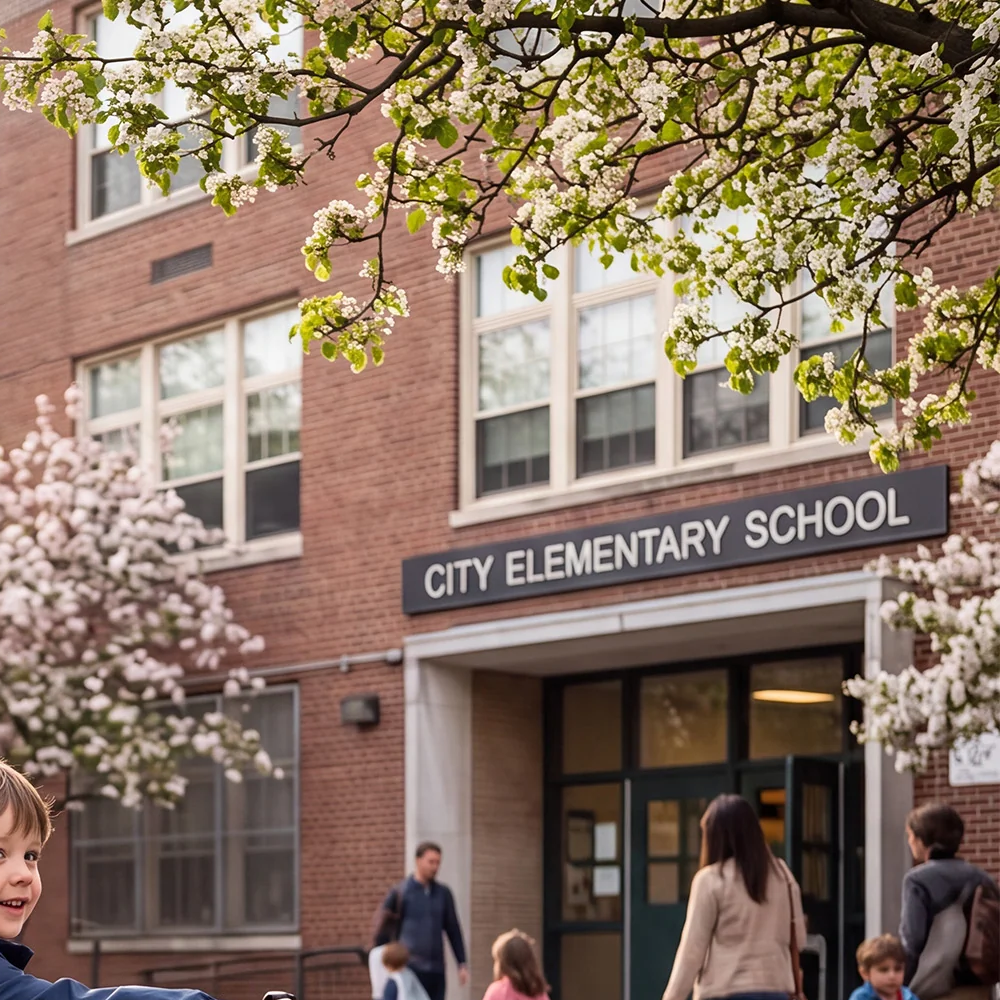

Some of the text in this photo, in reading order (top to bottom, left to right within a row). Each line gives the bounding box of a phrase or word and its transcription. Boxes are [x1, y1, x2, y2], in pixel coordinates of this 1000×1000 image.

[424, 487, 910, 599] CITY ELEMENTARY SCHOOL
